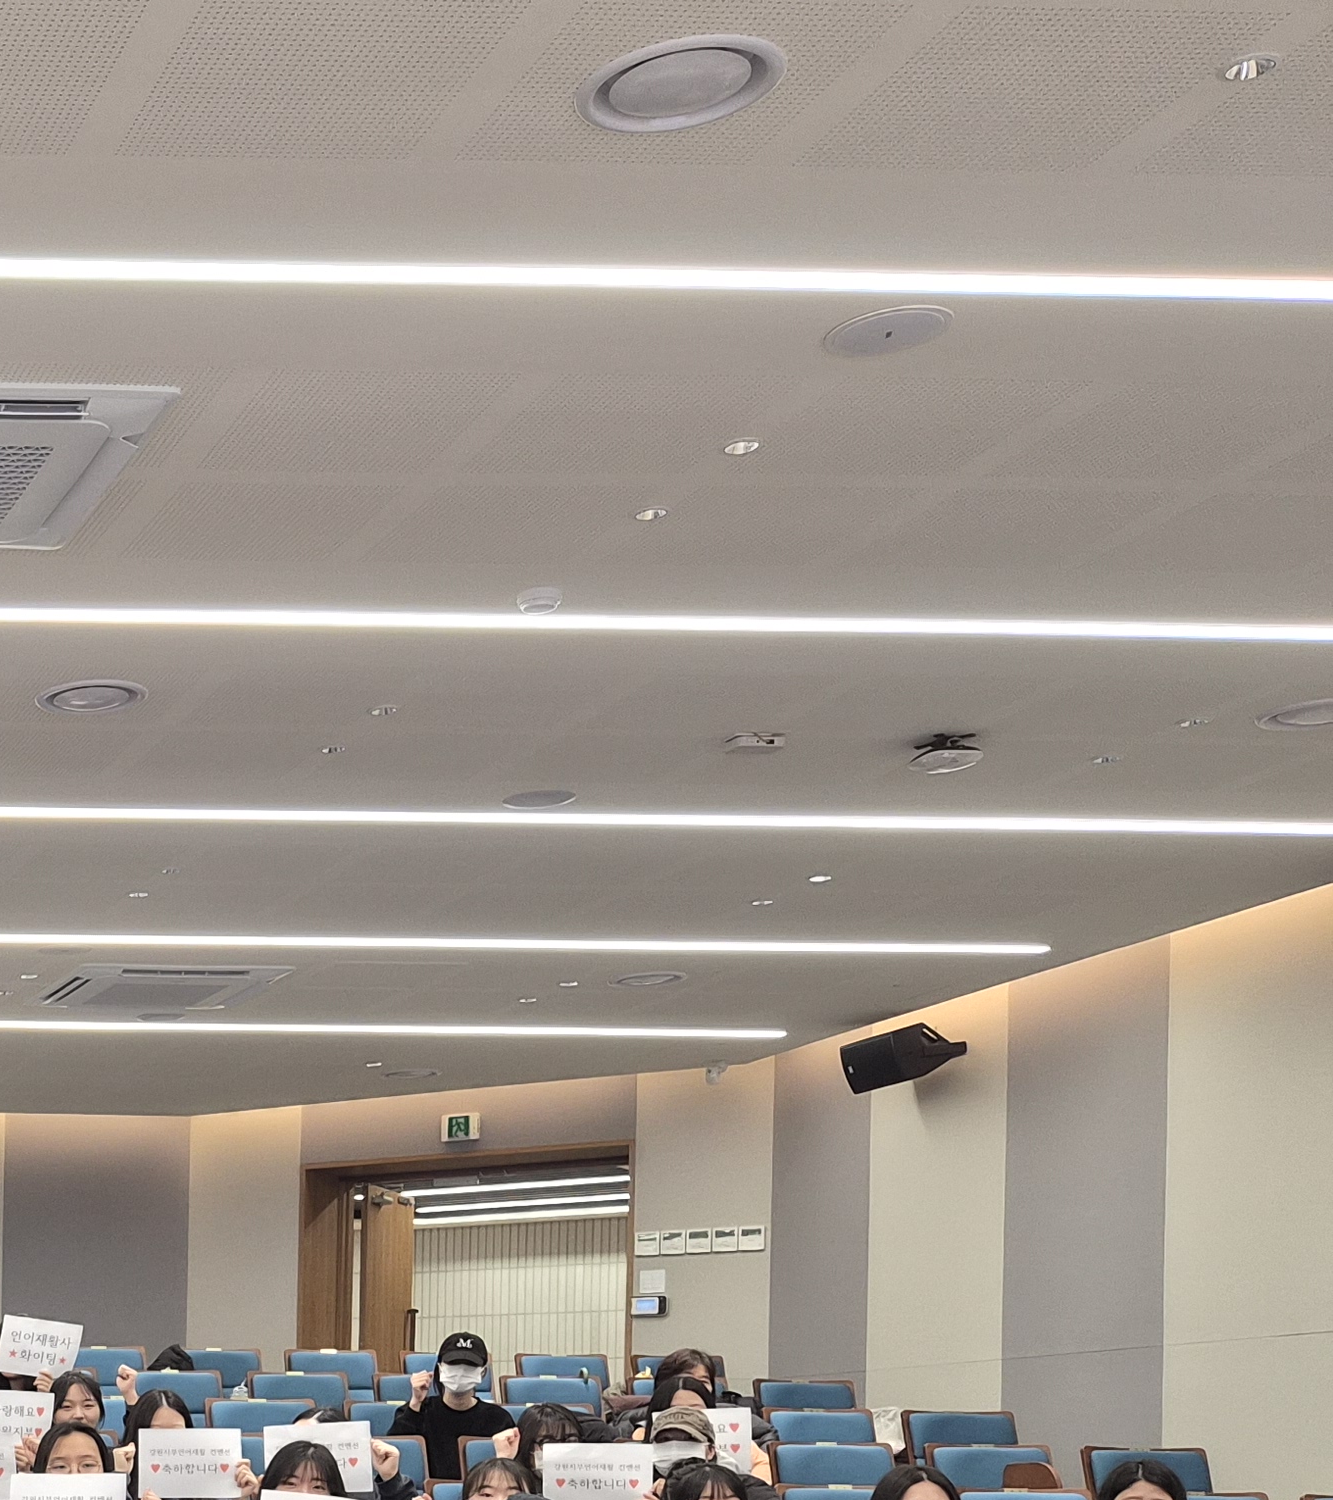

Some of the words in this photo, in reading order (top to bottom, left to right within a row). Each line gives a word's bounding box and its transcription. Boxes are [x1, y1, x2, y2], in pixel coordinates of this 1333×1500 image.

[10, 1330, 72, 1350] 언어재활사
[19, 1349, 57, 1366] 화이팅
[162, 1462, 218, 1475] 축하합니다
[567, 1477, 627, 1490] 축하합니다
